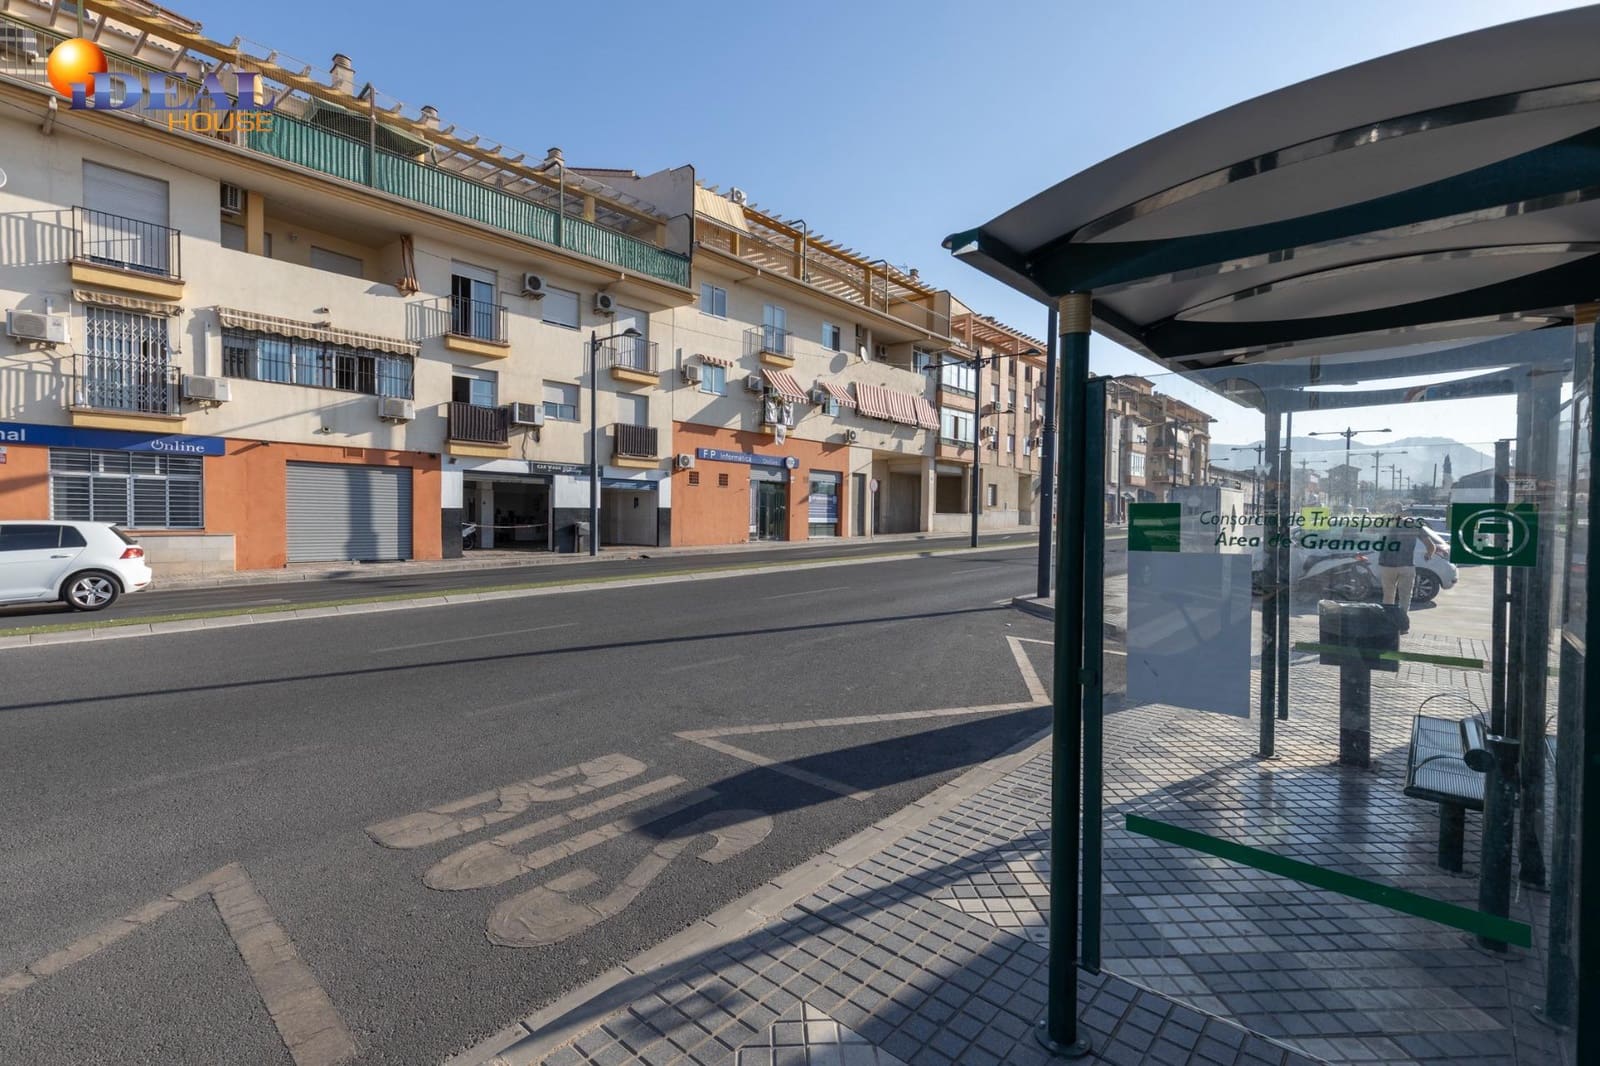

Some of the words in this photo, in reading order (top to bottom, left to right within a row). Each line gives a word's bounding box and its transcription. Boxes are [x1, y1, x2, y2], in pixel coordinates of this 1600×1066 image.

[151, 440, 205, 453] Online
[1200, 510, 1279, 527] Consorcio
[1288, 511, 1306, 527] de
[1311, 511, 1425, 532] Transportes
[1215, 527, 1260, 547] Área
[1268, 532, 1292, 549] de
[1301, 533, 1401, 552] Granada
[364, 752, 775, 948] BUS
